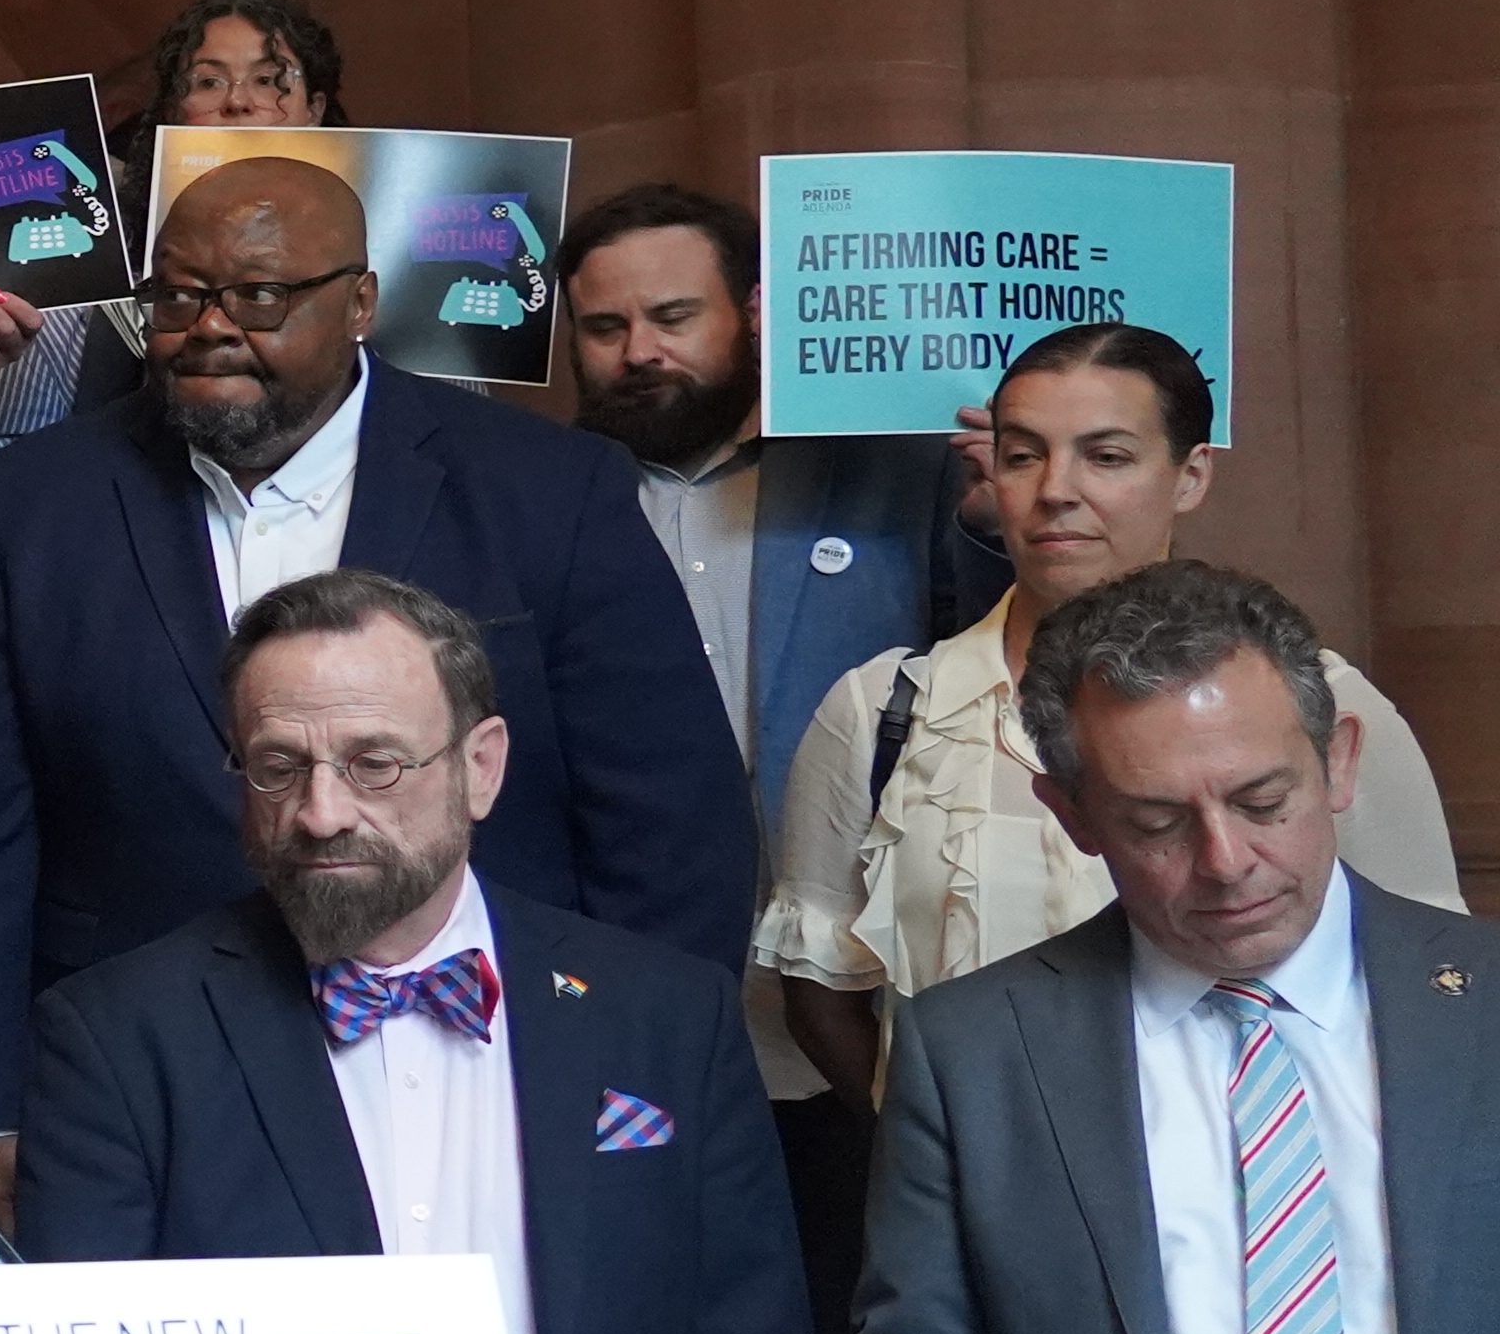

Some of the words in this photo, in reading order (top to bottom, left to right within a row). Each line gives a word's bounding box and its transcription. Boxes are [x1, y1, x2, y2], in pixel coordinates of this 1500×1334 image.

[802, 189, 852, 201] PRIDE
[798, 231, 985, 272] AFFIRMING
[996, 234, 1080, 271] CARE
[799, 284, 887, 323] CARE
[898, 282, 988, 320] THAT
[1000, 284, 1125, 324] HONORS
[800, 334, 910, 375] EVERY
[922, 333, 1014, 372] BODY
